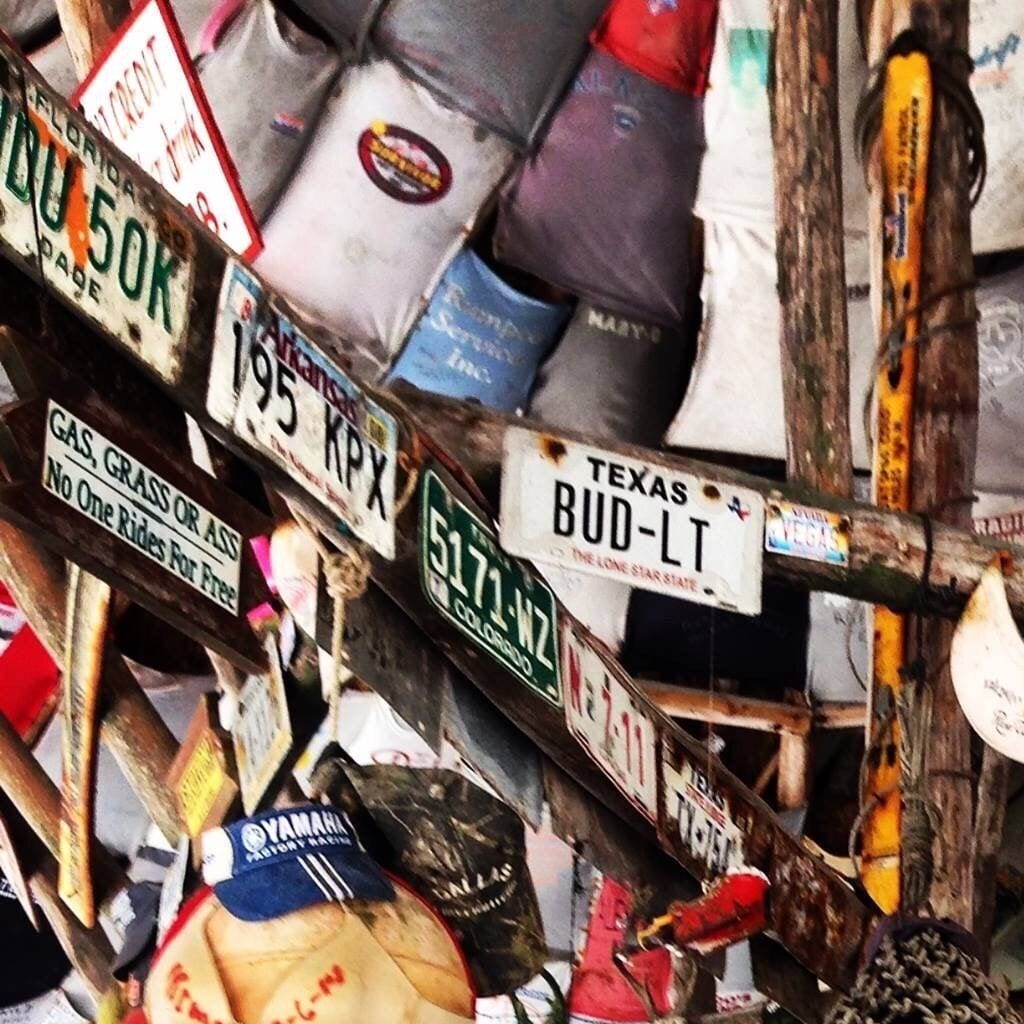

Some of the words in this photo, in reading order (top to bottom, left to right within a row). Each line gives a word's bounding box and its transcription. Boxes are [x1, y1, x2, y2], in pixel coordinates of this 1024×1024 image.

[34, 86, 136, 198] FLORIDA
[49, 408, 97, 469] GAS,
[103, 446, 171, 514] GRASS
[174, 495, 200, 537] OR
[204, 518, 239, 563] ASS
[324, 401, 388, 521] KPX
[587, 456, 689, 506] TEXAS
[48, 456, 73, 502] No
[77, 479, 115, 529] One
[117, 503, 167, 564] Rides
[170, 537, 198, 585] For
[200, 560, 238, 611] Free
[553, 478, 712, 574] BUD-LT
[571, 547, 594, 568] THE
[597, 554, 629, 577] LONE
[630, 561, 663, 584] STAR
[662, 571, 700, 594] STATE
[454, 602, 534, 678] COLORADO
[260, 809, 348, 843] YAMAHA
